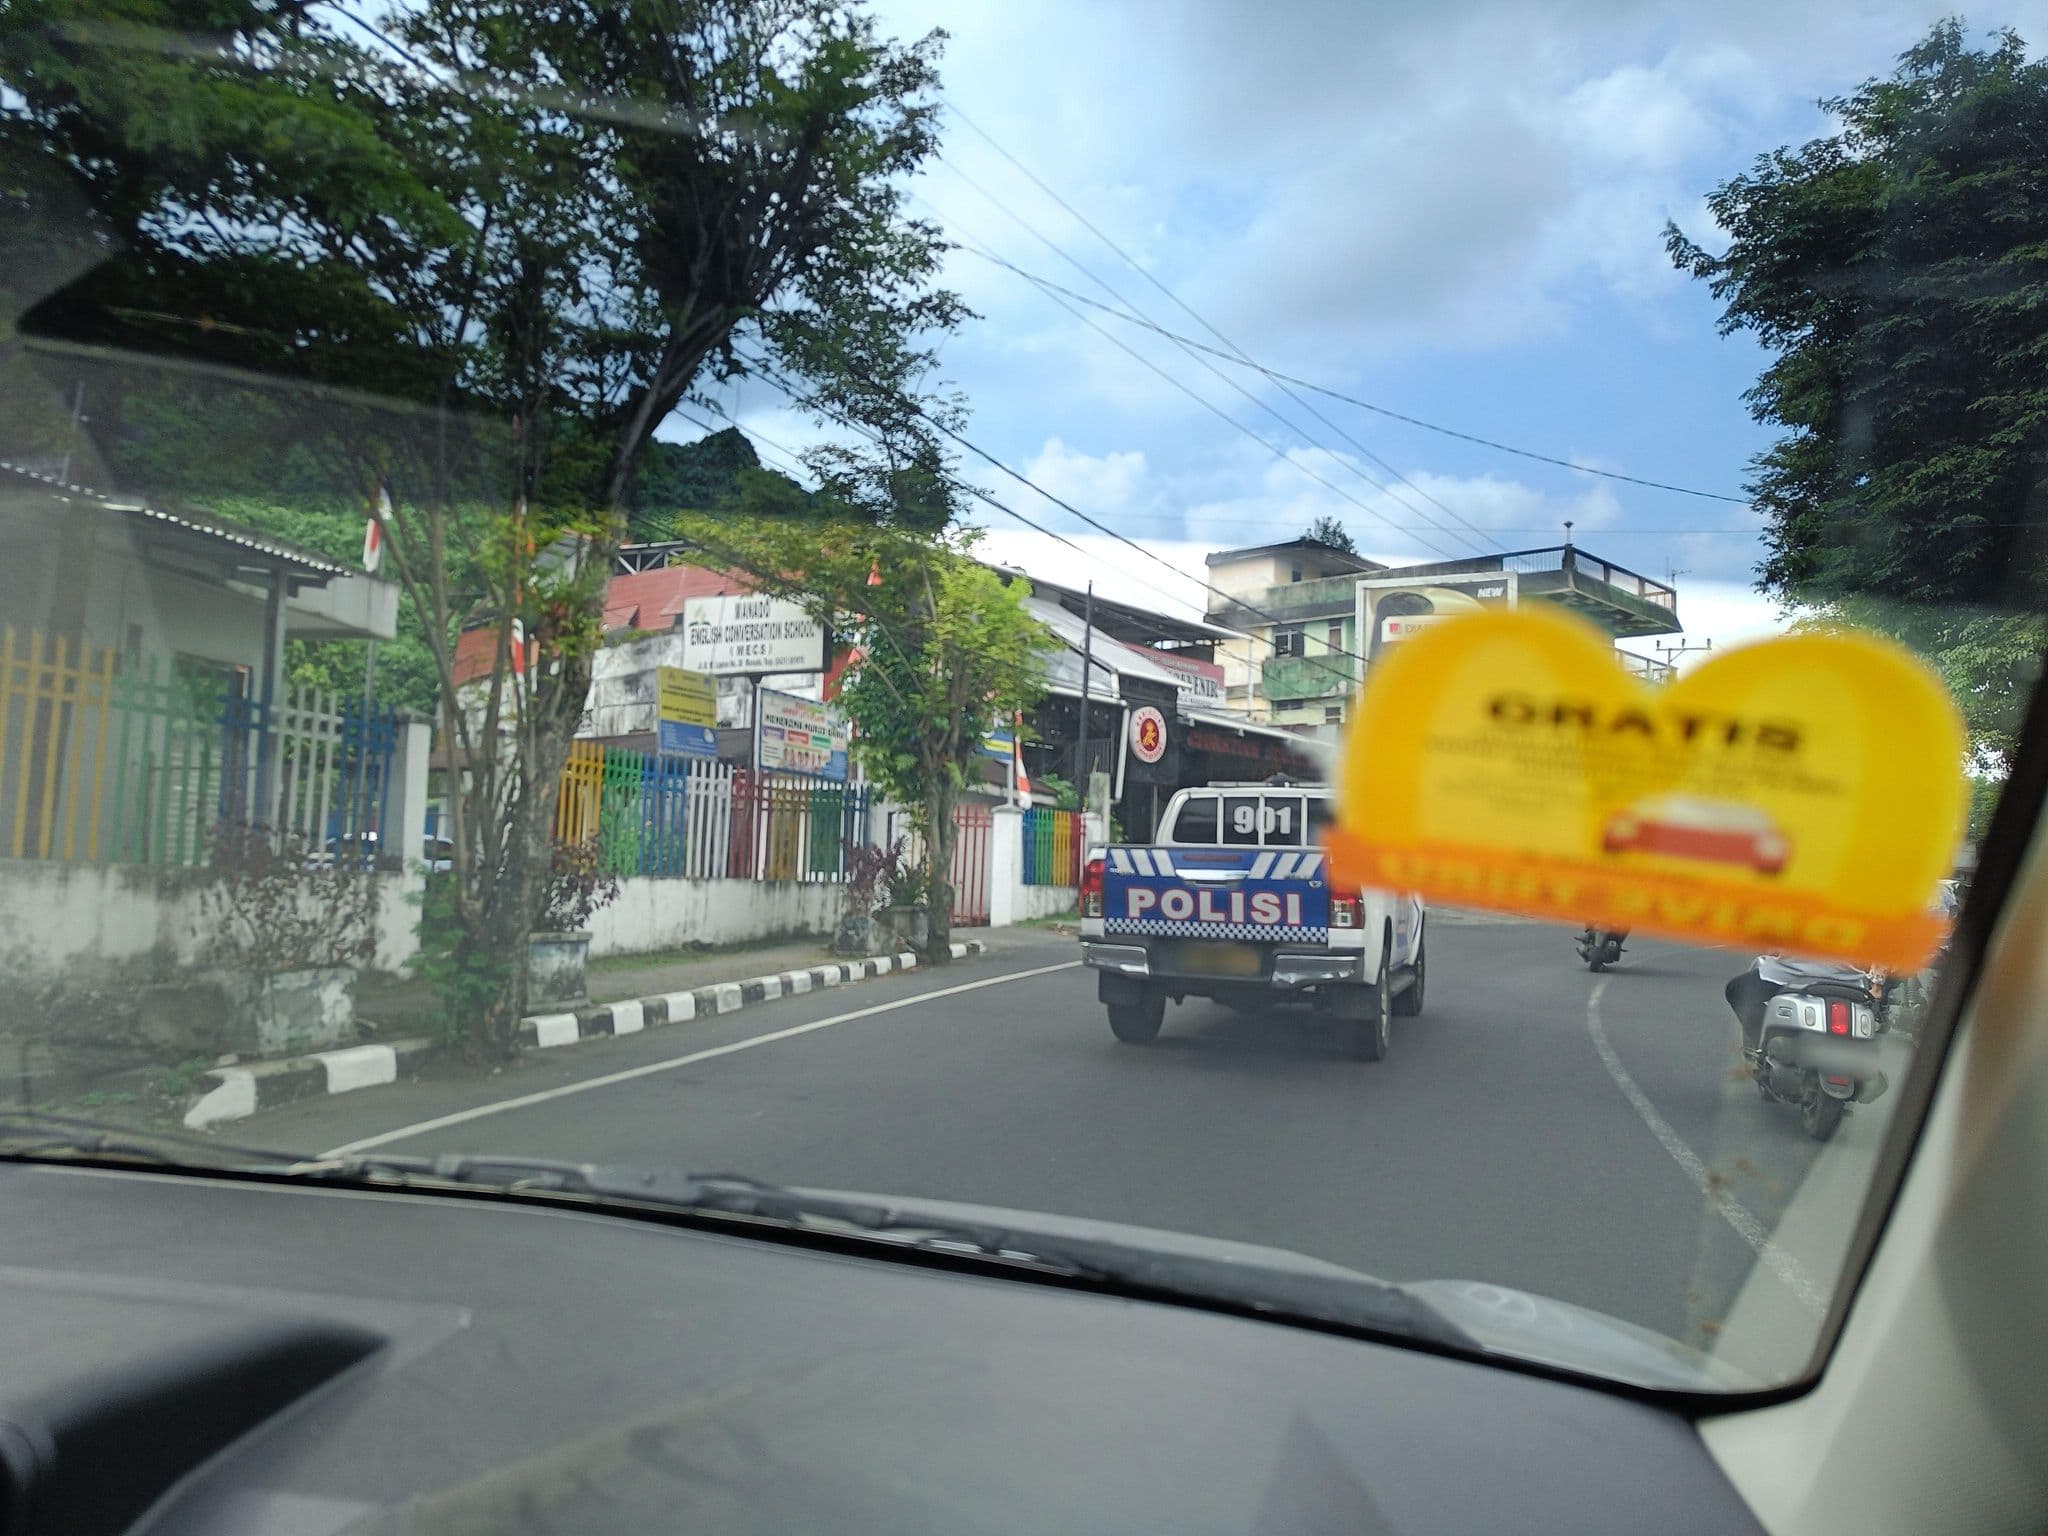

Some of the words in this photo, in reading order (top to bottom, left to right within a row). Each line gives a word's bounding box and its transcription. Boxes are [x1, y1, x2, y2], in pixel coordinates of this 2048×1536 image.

[1477, 586, 1504, 599] NEW
[735, 600, 771, 619] MANADO
[690, 627, 722, 646] ENGLISH
[724, 621, 782, 643] CONVERSATION
[784, 619, 816, 640] SCHOOL
[1486, 691, 1803, 751] GRATIS
[1233, 805, 1292, 835] 901
[1126, 887, 1303, 926] POLISI
